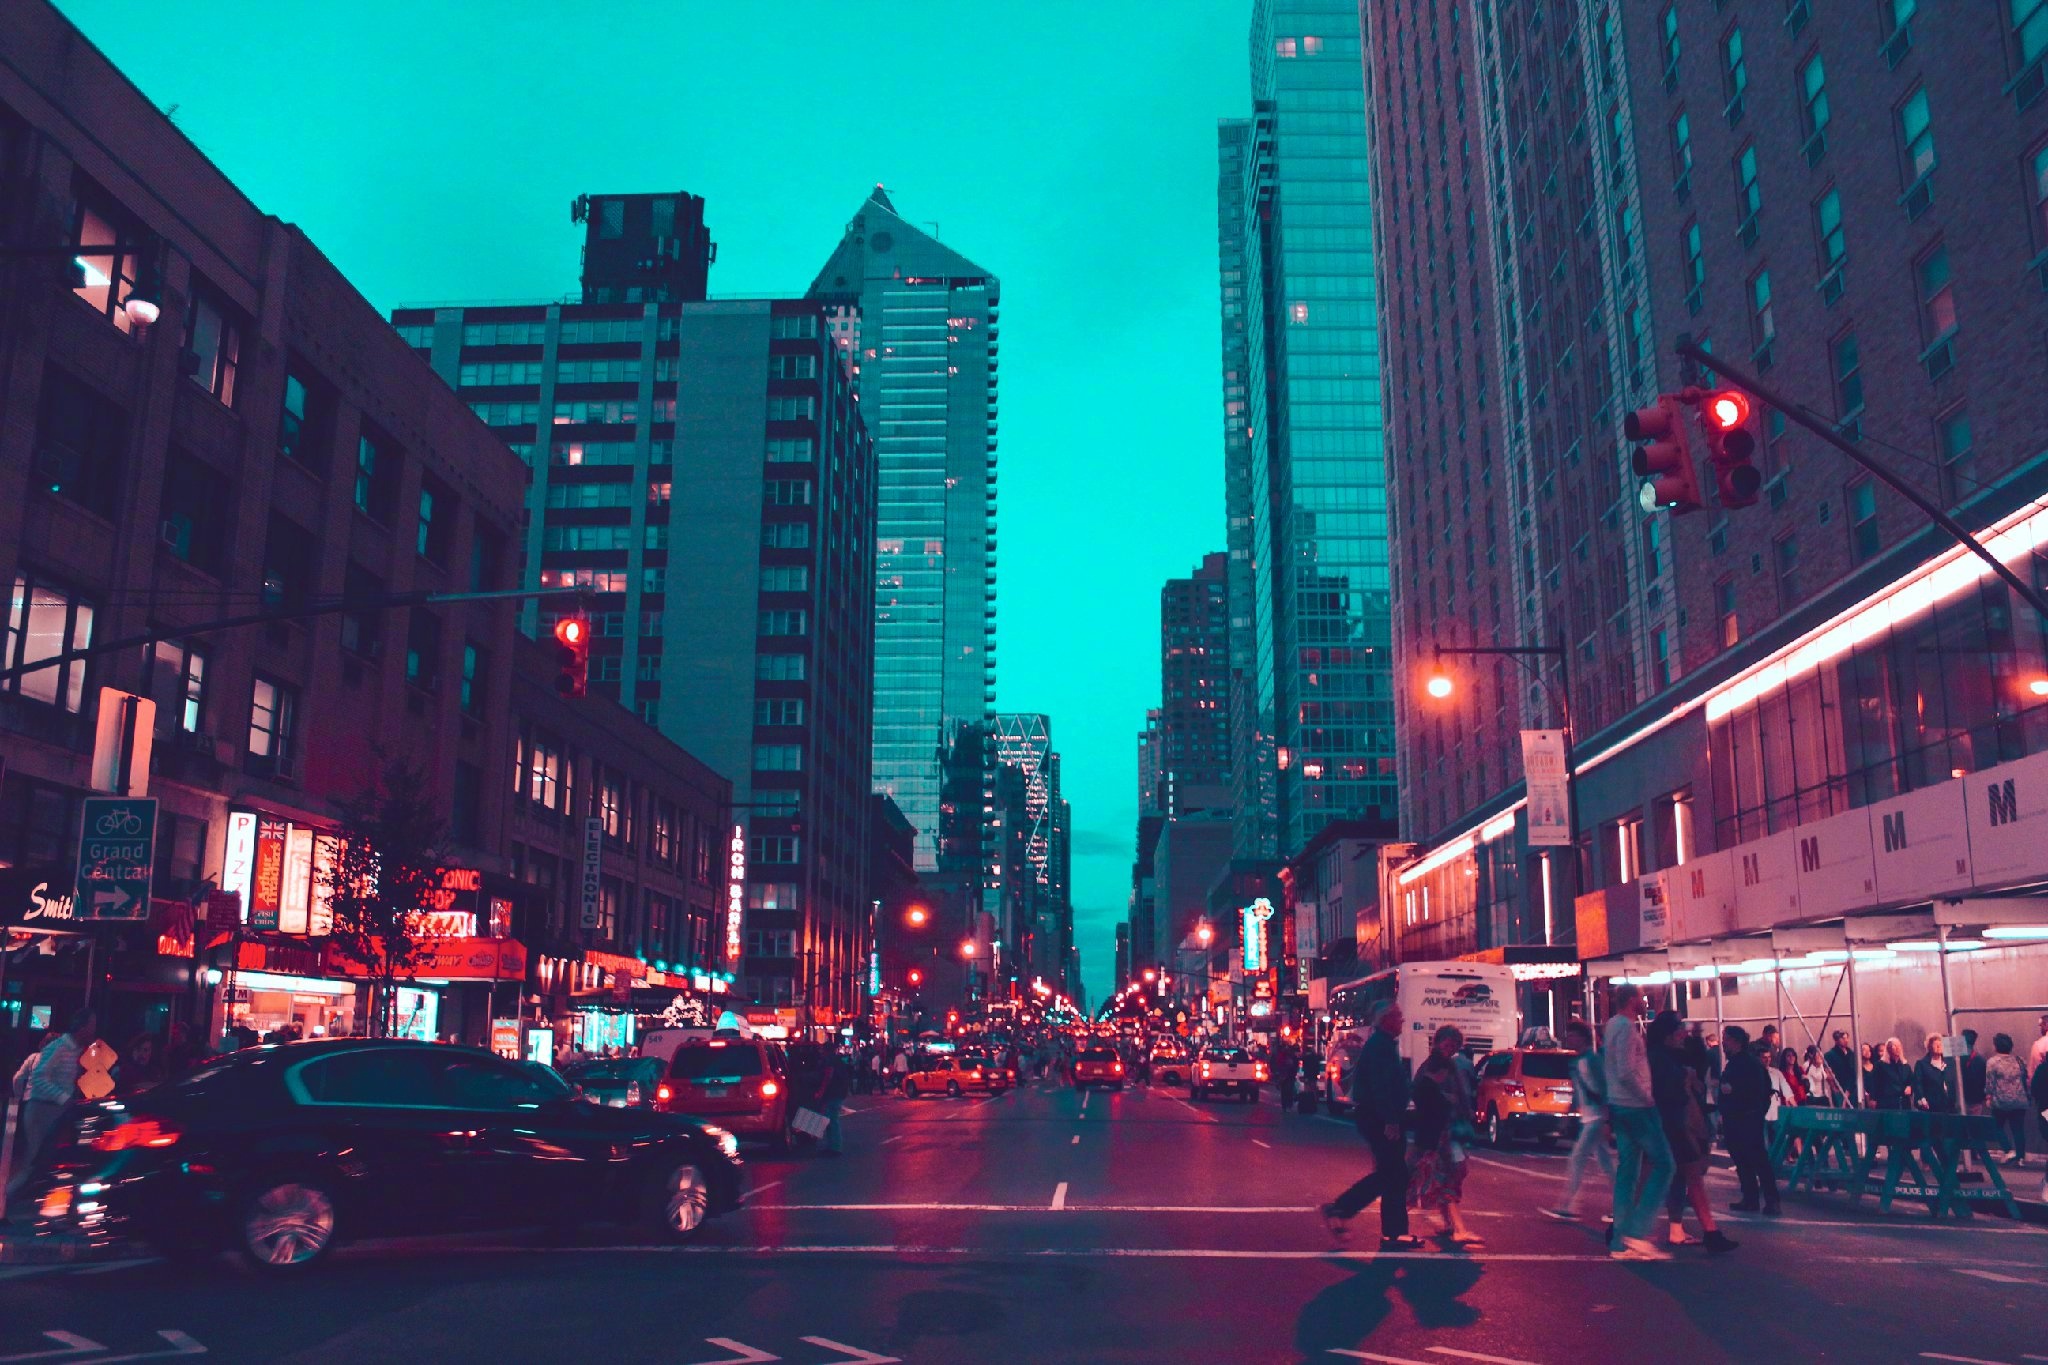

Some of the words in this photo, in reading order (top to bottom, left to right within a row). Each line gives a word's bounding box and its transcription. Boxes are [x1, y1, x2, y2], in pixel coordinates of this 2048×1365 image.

[1988, 778, 2017, 827] M
[1883, 810, 1907, 853] M
[90, 843, 144, 859] Grand
[731, 825, 745, 879] IRON
[1801, 836, 1820, 873] M
[81, 863, 153, 880] Central
[583, 822, 599, 924] ELECTRONIC
[1691, 869, 1705, 899] M
[1743, 853, 1760, 887] M
[727, 883, 742, 925] BAR
[649, 1035, 663, 1044] 549
[1895, 1186, 1922, 1196] POLICE
[1925, 1187, 1940, 1196] DEP
[1982, 1190, 2001, 1198] DEPT
